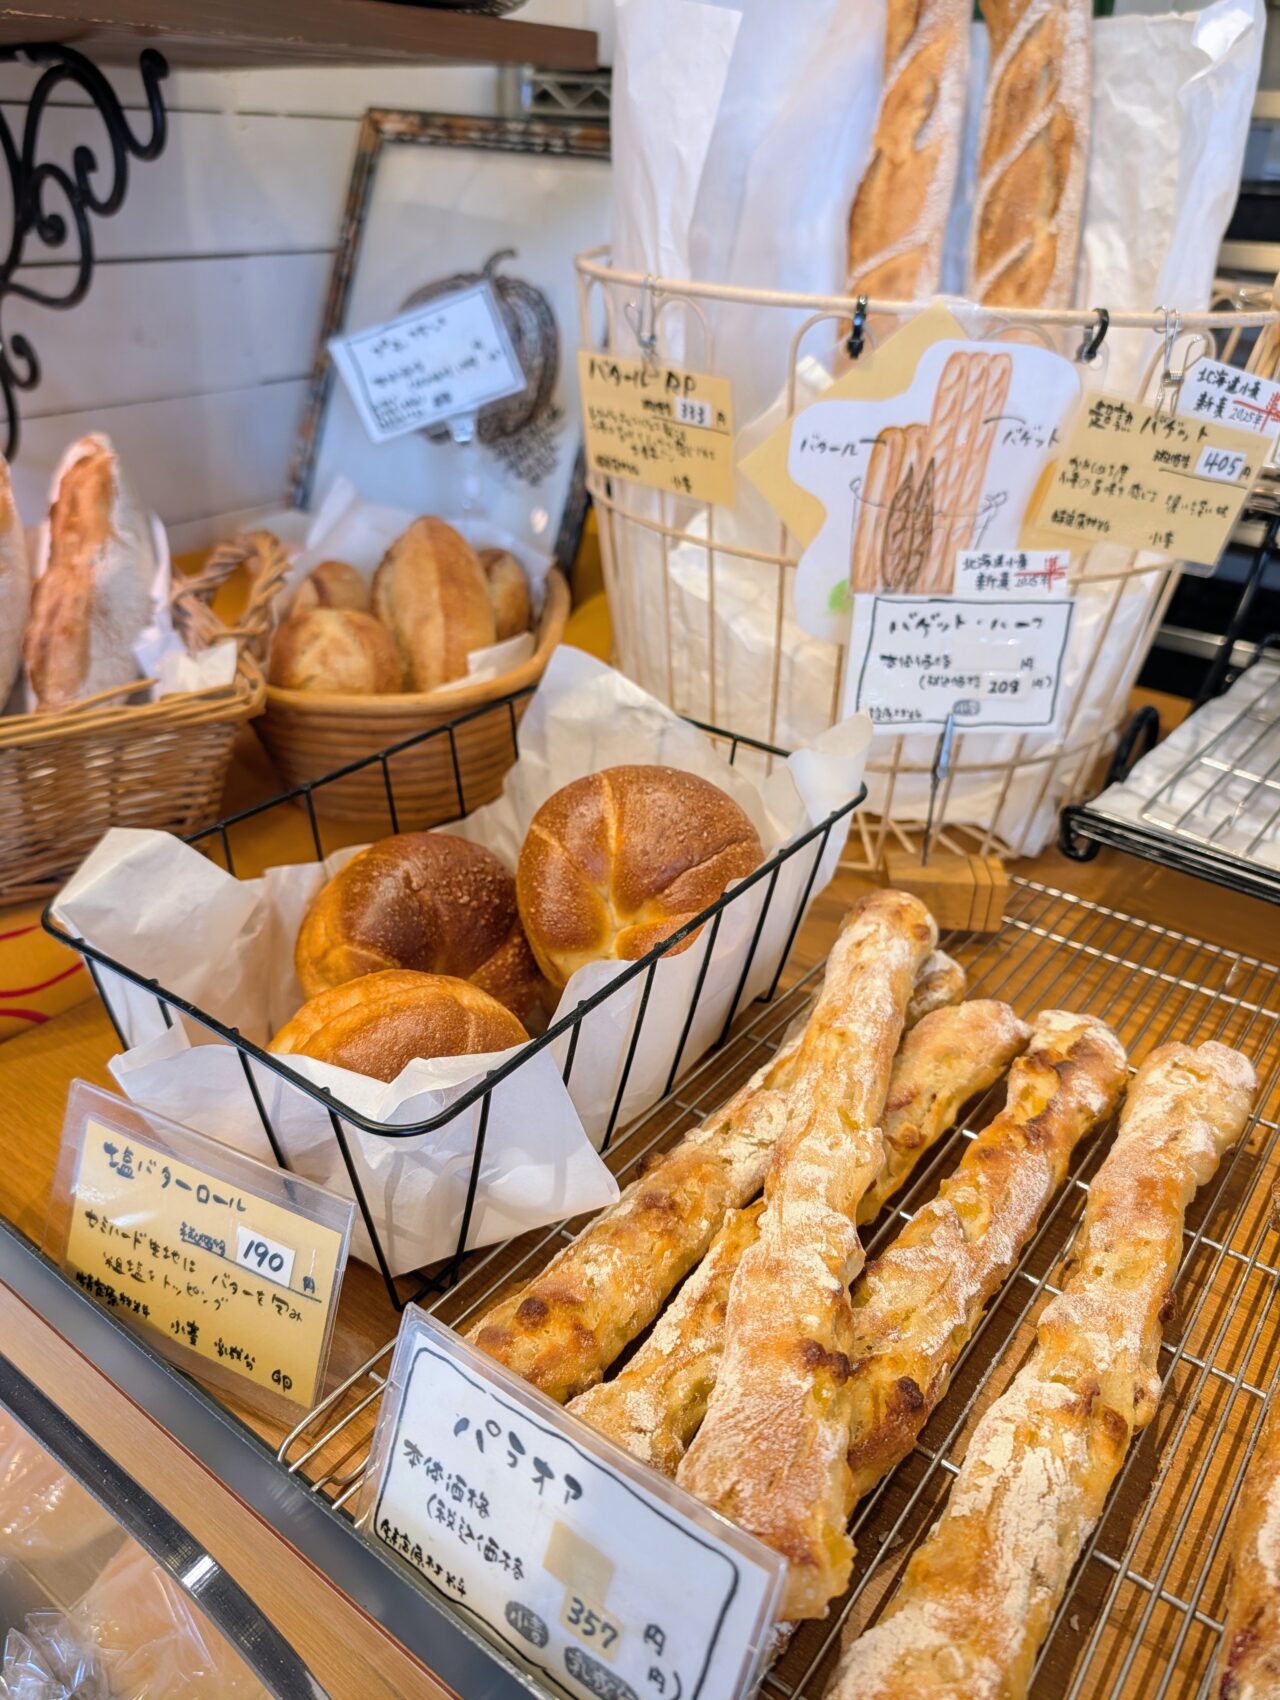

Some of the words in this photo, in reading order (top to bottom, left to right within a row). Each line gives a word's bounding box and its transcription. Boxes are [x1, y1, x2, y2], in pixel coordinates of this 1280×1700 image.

[681, 403, 705, 424] 333
[800, 434, 858, 456] バタール
[1203, 452, 1243, 479] 405
[988, 680, 1020, 694] 208
[103, 1141, 246, 1212] 塩バターロール
[243, 1239, 285, 1273] 190
[302, 1275, 318, 1294] 円
[403, 1439, 491, 1519] 本体価格
[453, 1417, 583, 1504] パラオア
[567, 1597, 619, 1649] 357
[643, 1624, 666, 1656] 円
